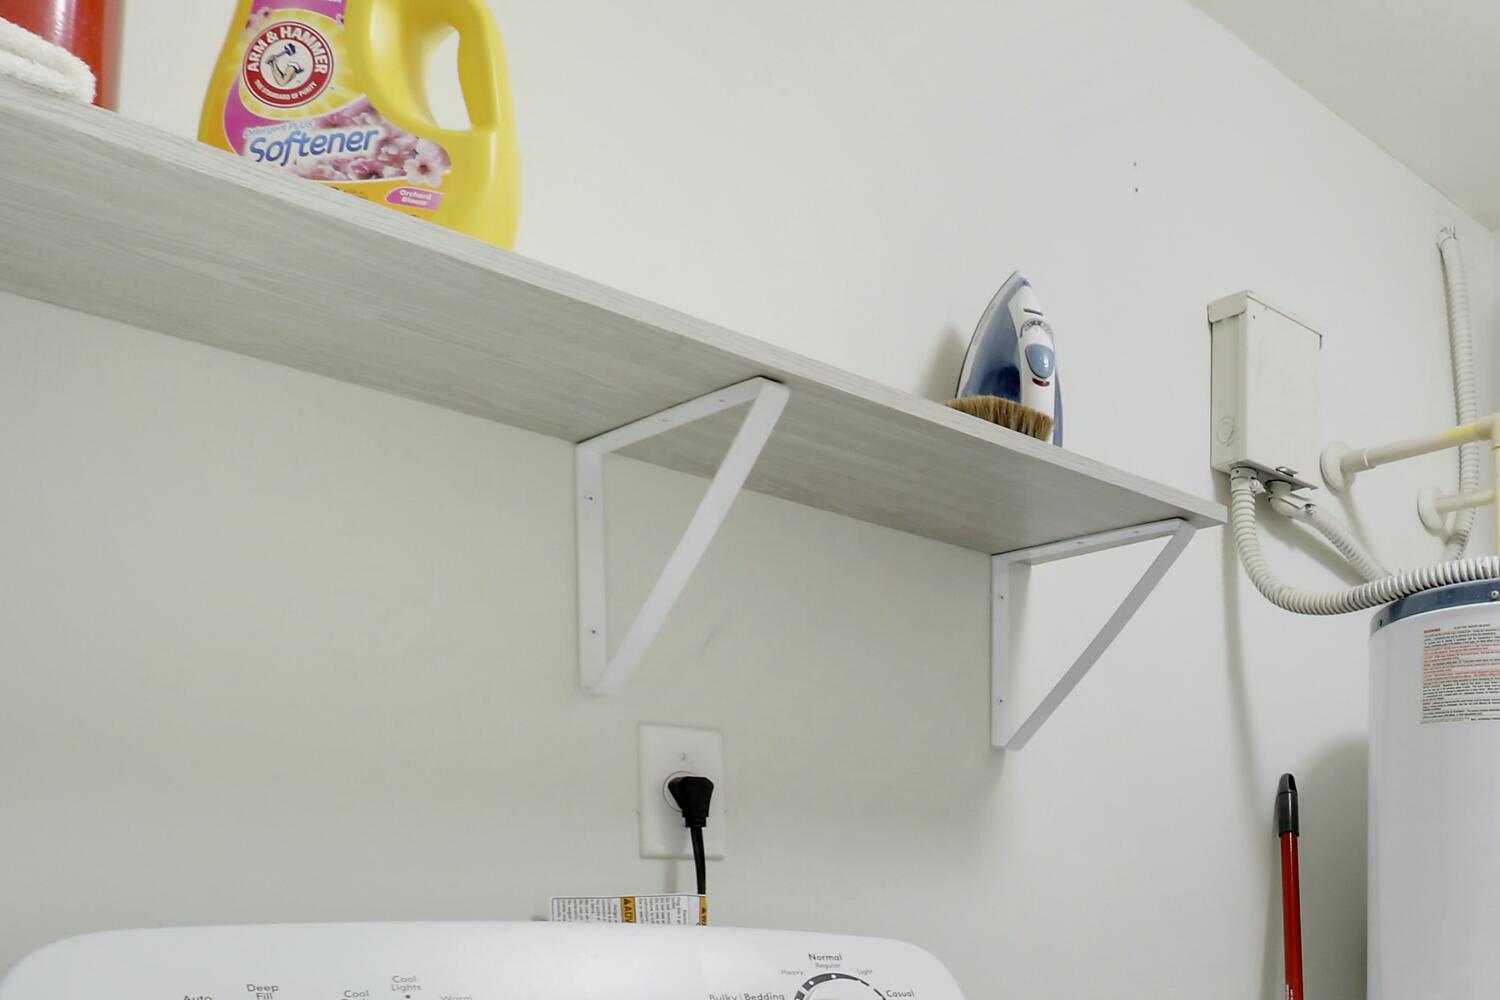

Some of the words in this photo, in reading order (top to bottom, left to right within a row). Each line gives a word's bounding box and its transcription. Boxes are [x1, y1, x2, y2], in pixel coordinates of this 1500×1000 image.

[247, 38, 268, 73] ARM
[265, 30, 280, 43] &
[280, 26, 329, 74] HAMMER
[250, 129, 380, 167] Softener
[399, 188, 433, 201] Orchard
[808, 953, 843, 962] Normal
[391, 975, 417, 984] Cool
[246, 984, 280, 993] Deep
[391, 983, 422, 992] Lights
[256, 992, 273, 1000] Fill
[343, 989, 370, 998] Cool
[885, 989, 915, 998] Casual
